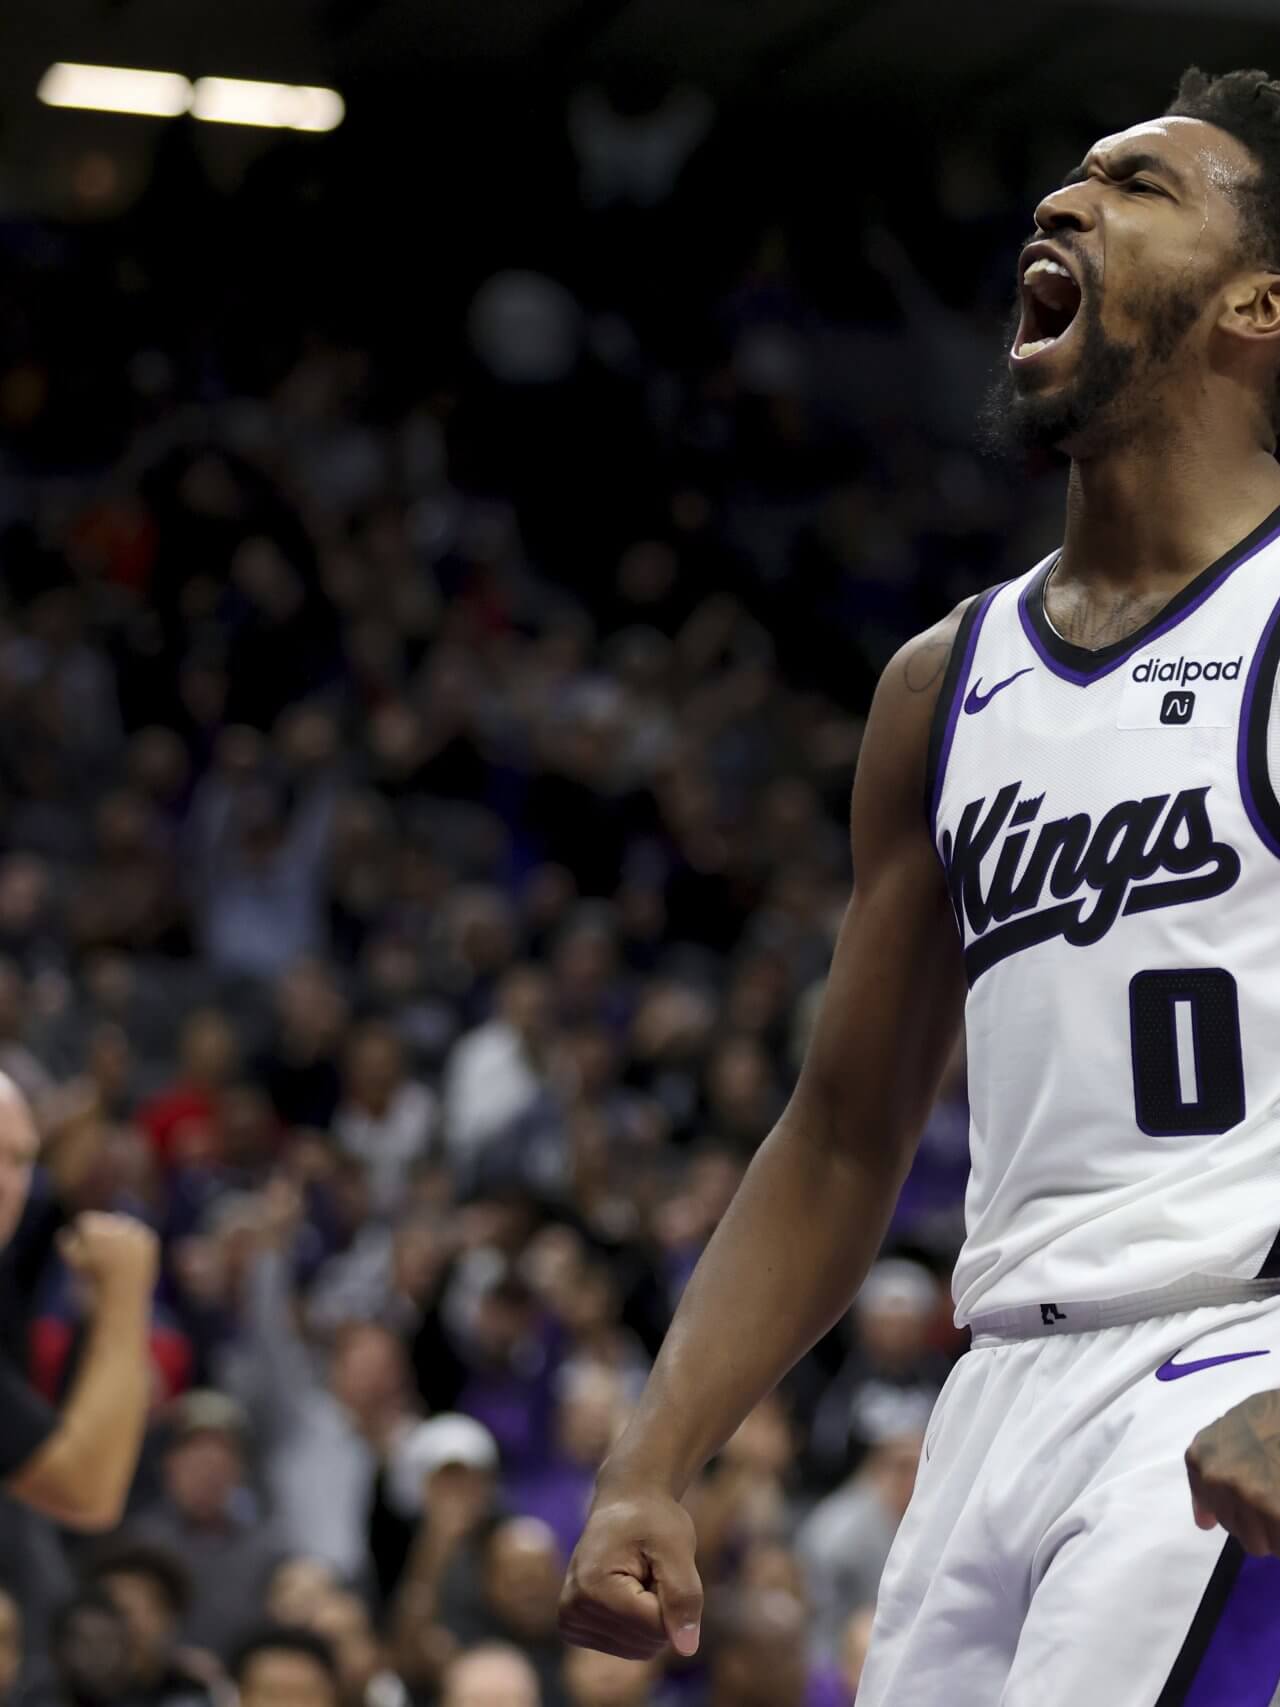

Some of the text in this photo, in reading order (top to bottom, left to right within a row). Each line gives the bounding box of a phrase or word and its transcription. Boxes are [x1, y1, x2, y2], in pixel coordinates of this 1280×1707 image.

[1132, 656, 1243, 687] dialpad
[942, 780, 1241, 990] Kings
[1129, 967, 1246, 1137] 0
